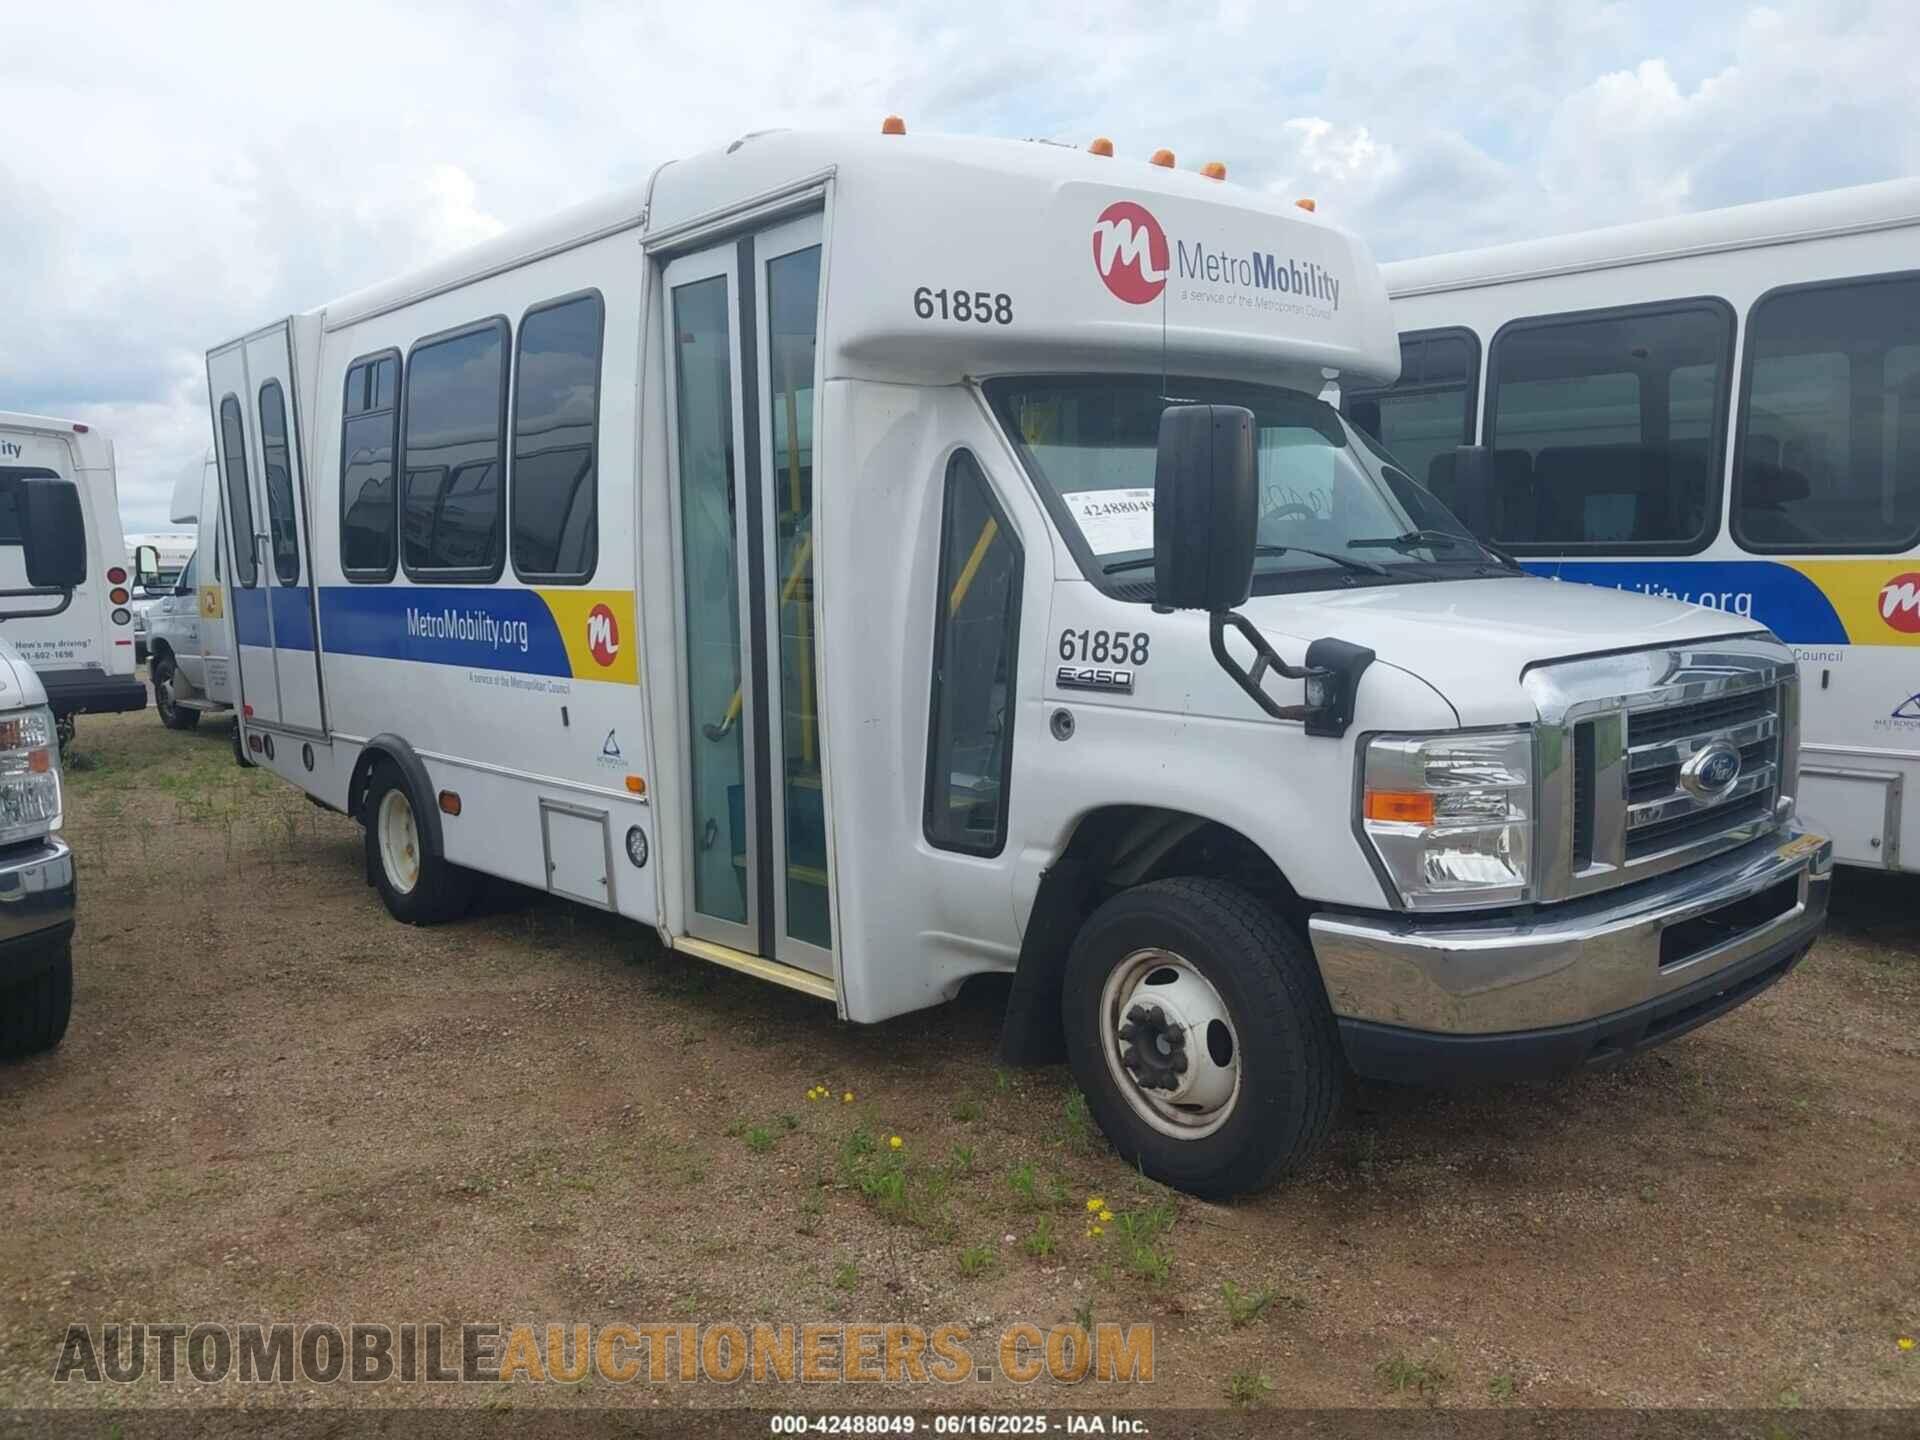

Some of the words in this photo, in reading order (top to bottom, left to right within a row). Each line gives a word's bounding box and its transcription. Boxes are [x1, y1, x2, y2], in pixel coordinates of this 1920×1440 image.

[1177, 240, 1339, 310] MetroMobility
[914, 287, 1013, 324] 61858
[1181, 290, 1188, 300] a
[1190, 291, 1225, 304] service
[1227, 292, 1238, 305] of
[1239, 294, 1252, 306] the
[16, 640, 41, 649] How's
[43, 641, 56, 649] my
[407, 608, 529, 652] MetroMobility.org
[1059, 629, 1150, 666] 61858
[1793, 648, 1844, 663] Council
